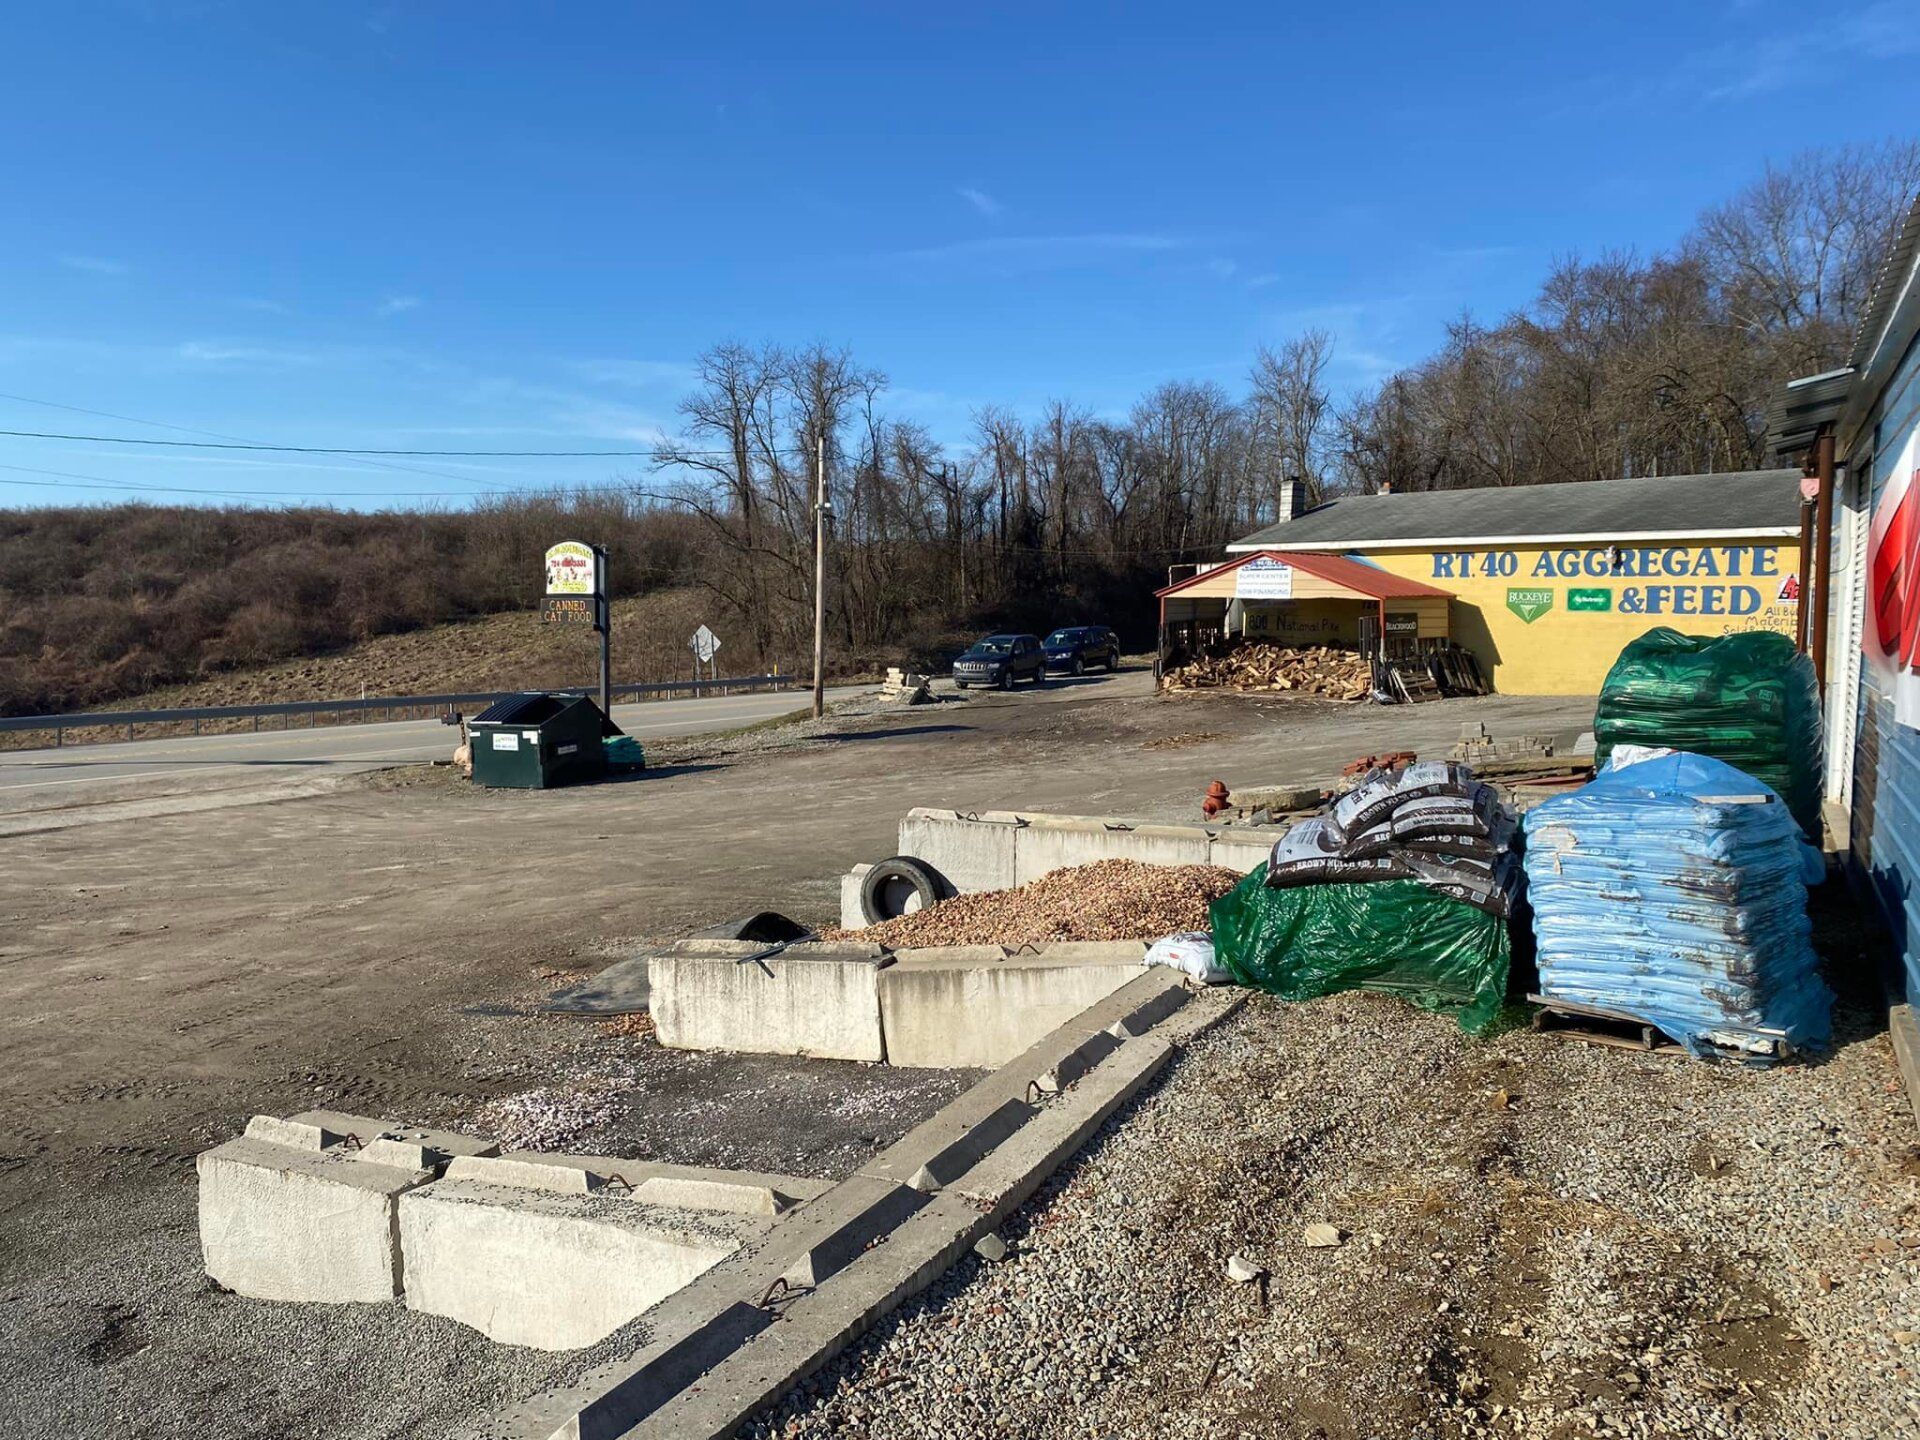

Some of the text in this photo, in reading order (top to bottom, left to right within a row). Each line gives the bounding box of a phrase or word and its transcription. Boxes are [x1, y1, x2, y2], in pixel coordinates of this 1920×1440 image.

[1531, 546, 1779, 577] AGGREGATE
[1508, 591, 1553, 604] BUCKEYE
[549, 600, 586, 611] CANNED
[1764, 606, 1781, 616] All
[544, 611, 592, 622] CAT FOOD
[1359, 800, 1387, 822] BROWN
[1296, 858, 1326, 870] BROWN
